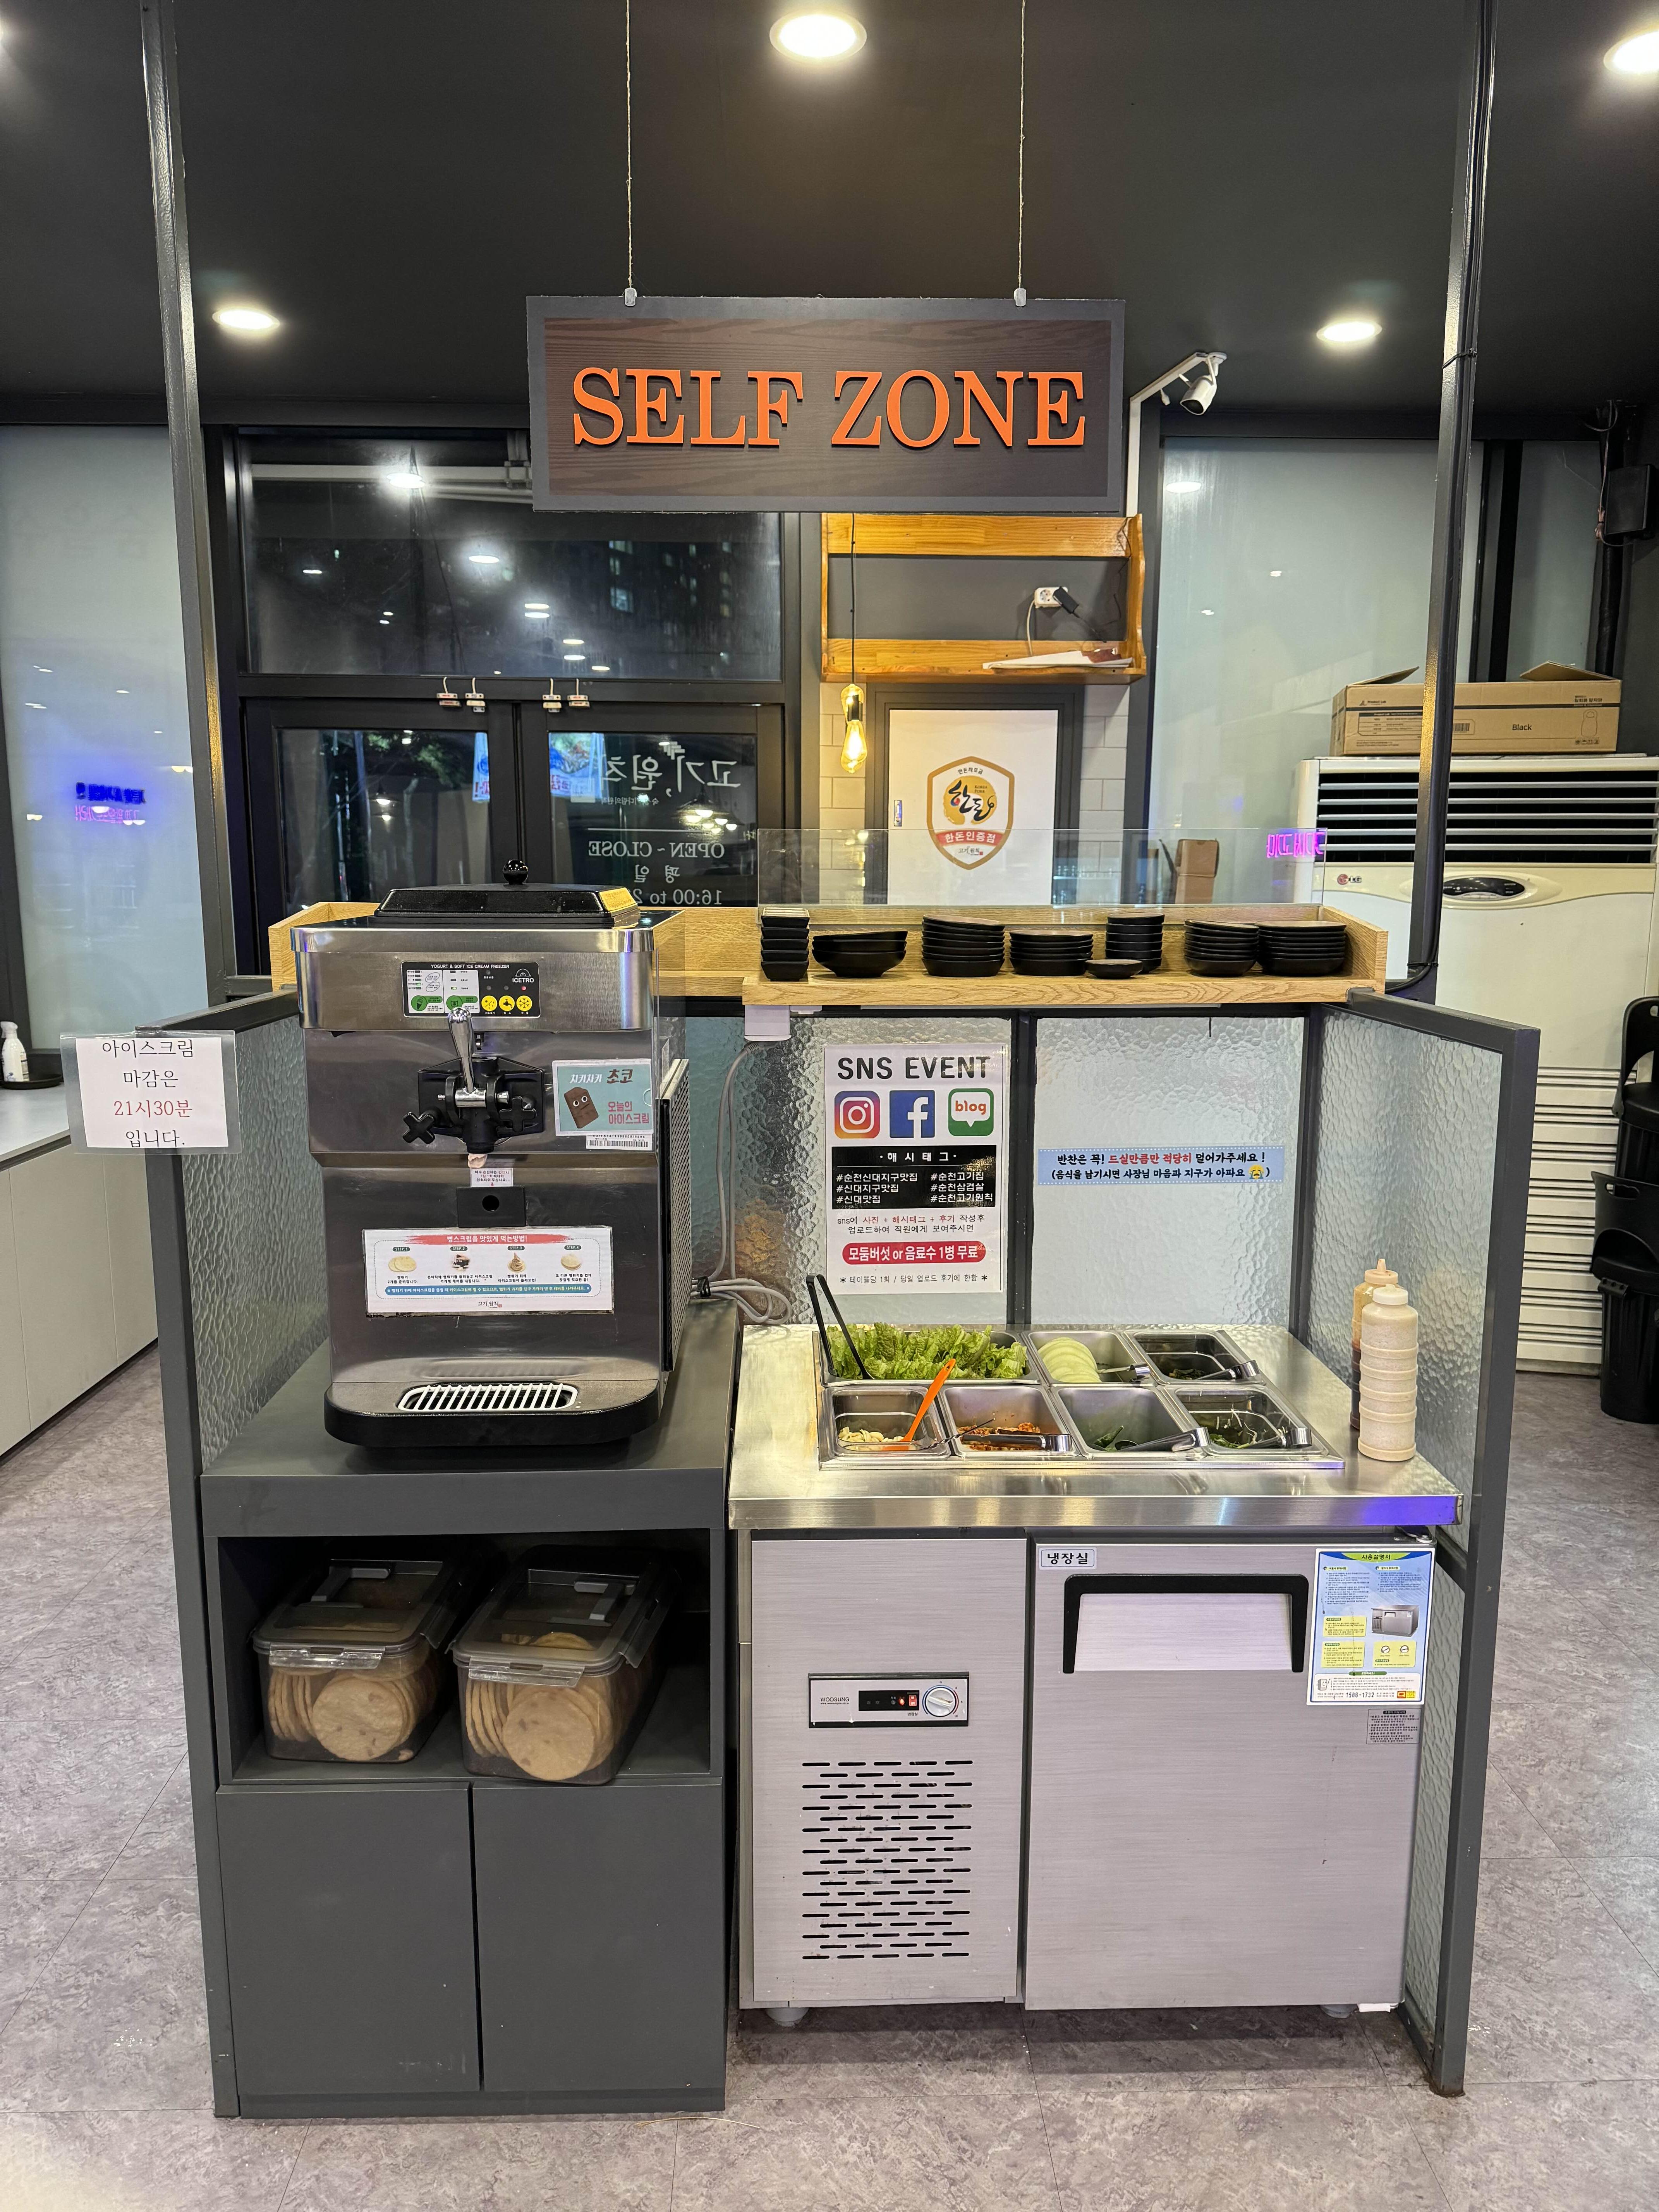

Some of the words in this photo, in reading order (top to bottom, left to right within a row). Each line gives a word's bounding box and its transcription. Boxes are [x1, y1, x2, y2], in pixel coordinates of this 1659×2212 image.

[573, 367, 803, 446] SELF
[832, 369, 1085, 447] ZONE
[945, 831, 995, 843] 한돈인증점
[102, 1039, 193, 1058] 아이스크림
[838, 1057, 892, 1079] SNS
[905, 1056, 991, 1079] EVENT
[124, 1070, 178, 1088] 마감은
[607, 1069, 633, 1084] 초코
[114, 1100, 192, 1118] 21시30분
[608, 1101, 632, 1112] 오늘의
[956, 1101, 986, 1115] blog
[608, 1113, 649, 1124] 아이스크림
[126, 1130, 185, 1148] 입니다.
[1058, 1154, 1087, 1165] 반찬은
[1091, 1154, 1104, 1165] 꼭!
[1108, 1153, 1159, 1164] 드실만큼만
[1163, 1152, 1191, 1164] 적당히
[836, 1173, 917, 1182] #순천신대지구맛집
[931, 1172, 984, 1181] #순천고기집
[1052, 1170, 1082, 1180] (음식을
[1085, 1169, 1120, 1179] 남기시면
[1123, 1169, 1149, 1178] 사장님
[1154, 1168, 1181, 1178] 마음과
[1184, 1168, 1213, 1178] 지구가
[1216, 1168, 1245, 1177] 아파요
[836, 1184, 898, 1193] #신대지구맛집
[931, 1183, 984, 1192] #순천삼겹살
[836, 1195, 880, 1204] #신대맛집
[931, 1194, 993, 1202] #순천고기원칙
[849, 1248, 890, 1261] 모둠버섯
[893, 1250, 903, 1260] or
[905, 1247, 936, 1260] 음료수
[939, 1247, 954, 1259] 1병
[957, 1246, 978, 1258] 무료
[1048, 1553, 1088, 1564] 냉장실
